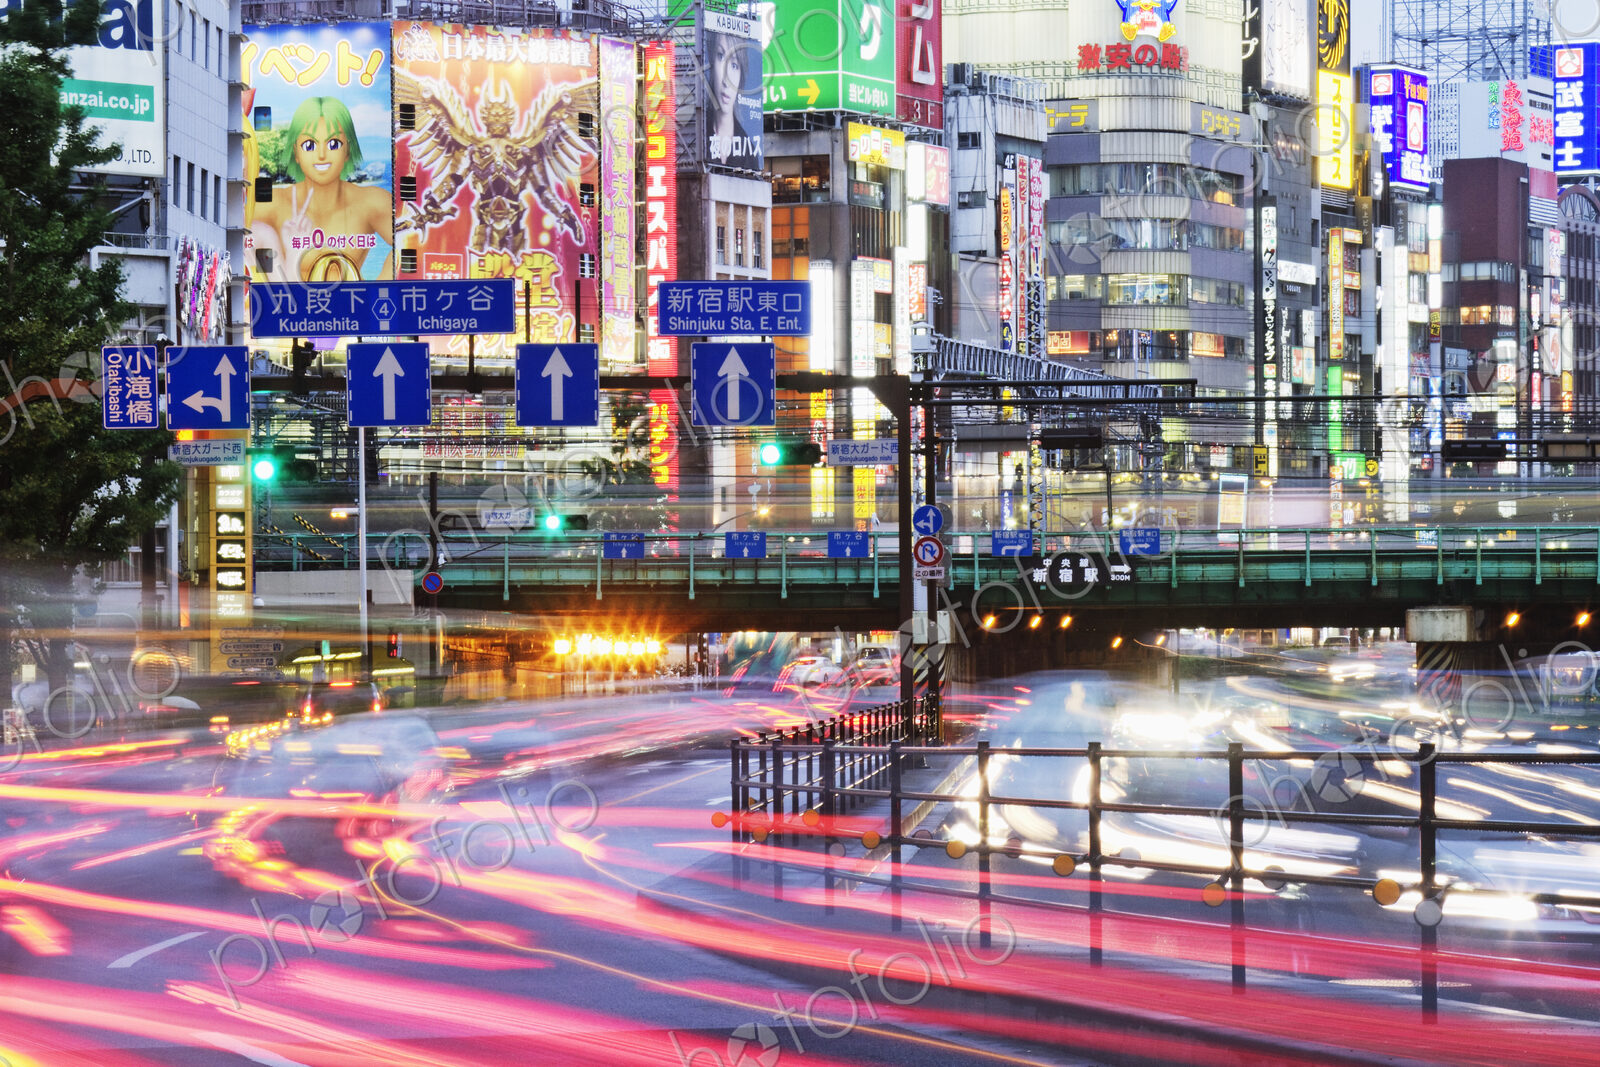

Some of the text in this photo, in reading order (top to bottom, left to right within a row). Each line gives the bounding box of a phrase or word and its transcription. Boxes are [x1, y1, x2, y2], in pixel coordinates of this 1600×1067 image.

[1078, 42, 1190, 71] 激安の殿
[59, 91, 150, 115] anzai.co.jp
[1556, 81, 1584, 167] 武富士
[291, 228, 377, 250] 毎月0の付く日は
[272, 287, 366, 315] 九段下
[379, 303, 389, 316] 4
[667, 287, 802, 314] 新宿駅東口
[278, 315, 478, 333] Kudanshita Ichigaya
[668, 316, 803, 332] Shinjuku Sta. E. Ent.
[108, 353, 123, 422] Otakibashi
[125, 351, 152, 424] 小滝橋
[172, 444, 241, 456] 新宿大ガード西
[831, 442, 899, 455] 新宿大ガード西
[915, 569, 943, 578] この場所
[1033, 567, 1099, 583] 新宿駅
